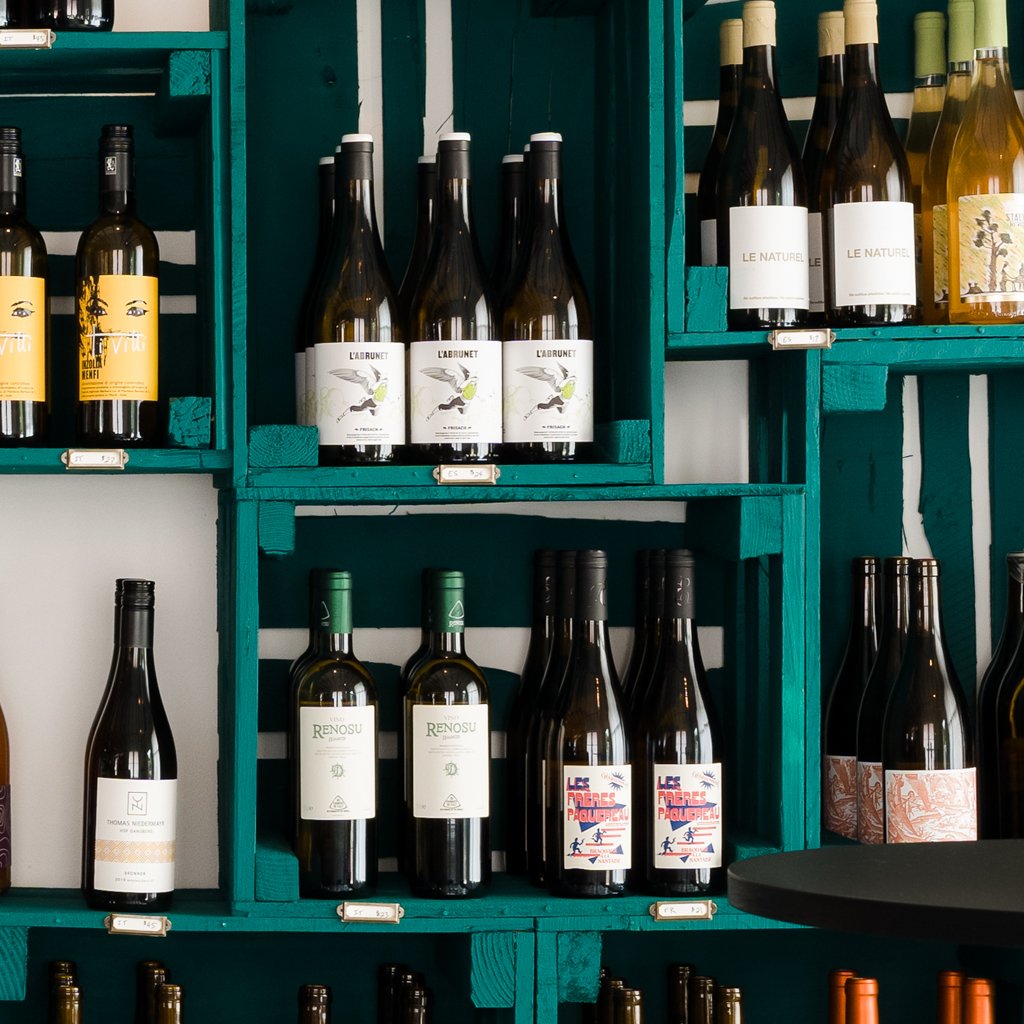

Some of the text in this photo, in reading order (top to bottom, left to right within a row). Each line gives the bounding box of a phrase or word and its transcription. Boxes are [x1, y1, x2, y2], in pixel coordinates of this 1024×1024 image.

[742, 252, 804, 263] LE NATUREL
[847, 248, 910, 259] LE NATUREL
[808, 257, 821, 267] LE
[349, 351, 388, 360] L'ABRUNET
[437, 350, 478, 359] L'ABRUNET
[536, 350, 576, 358] L'ABRUNET
[312, 724, 362, 739] RENOSU
[426, 722, 476, 737] RENOSU
[566, 776, 591, 791] LES
[656, 775, 681, 791] LES
